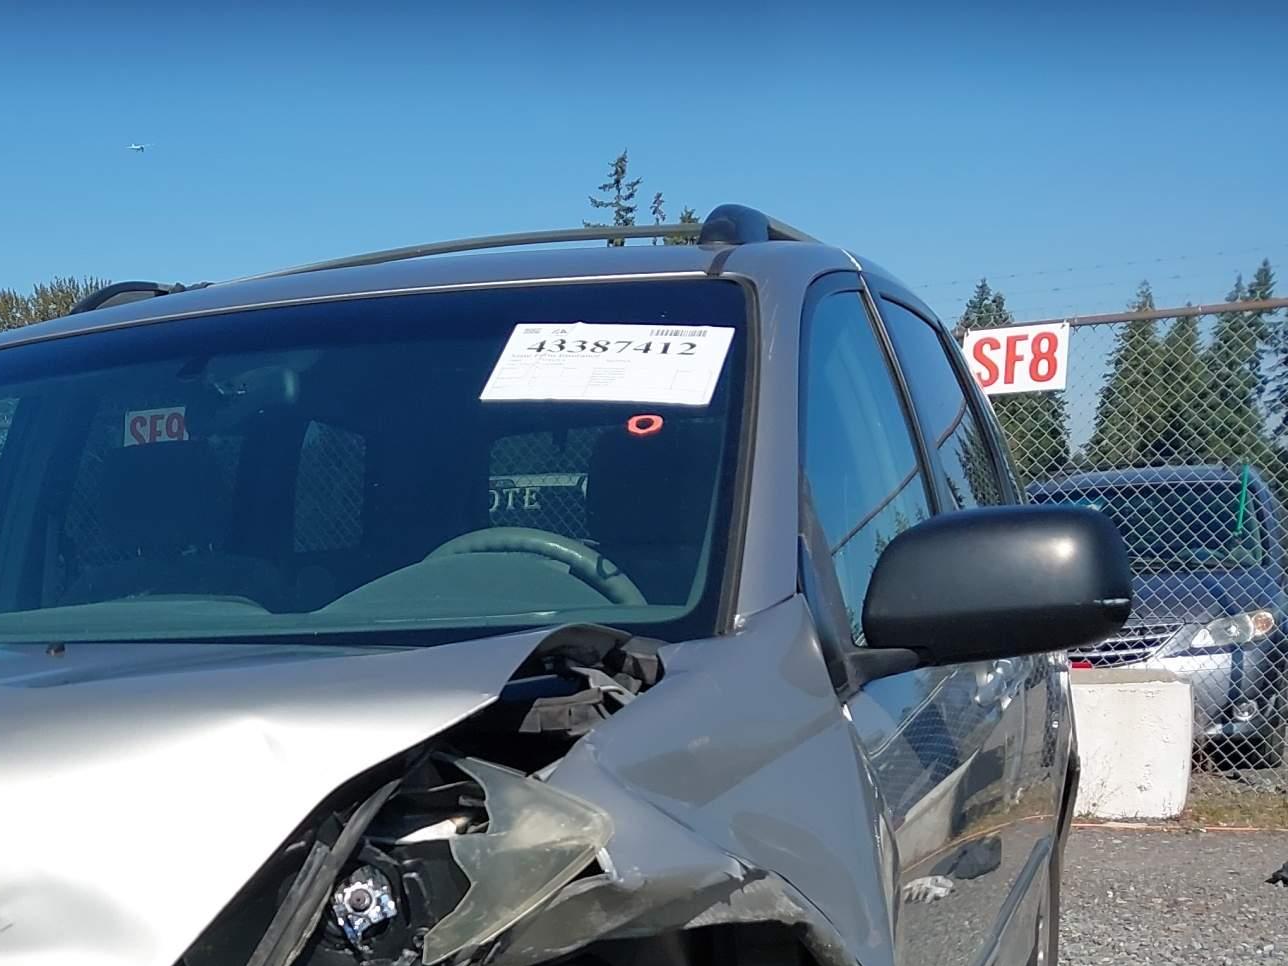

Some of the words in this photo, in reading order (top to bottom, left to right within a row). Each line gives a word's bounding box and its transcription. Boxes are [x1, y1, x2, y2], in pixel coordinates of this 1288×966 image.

[527, 338, 697, 356] 43387412
[973, 332, 1058, 388] SF8
[130, 412, 185, 445] SF9
